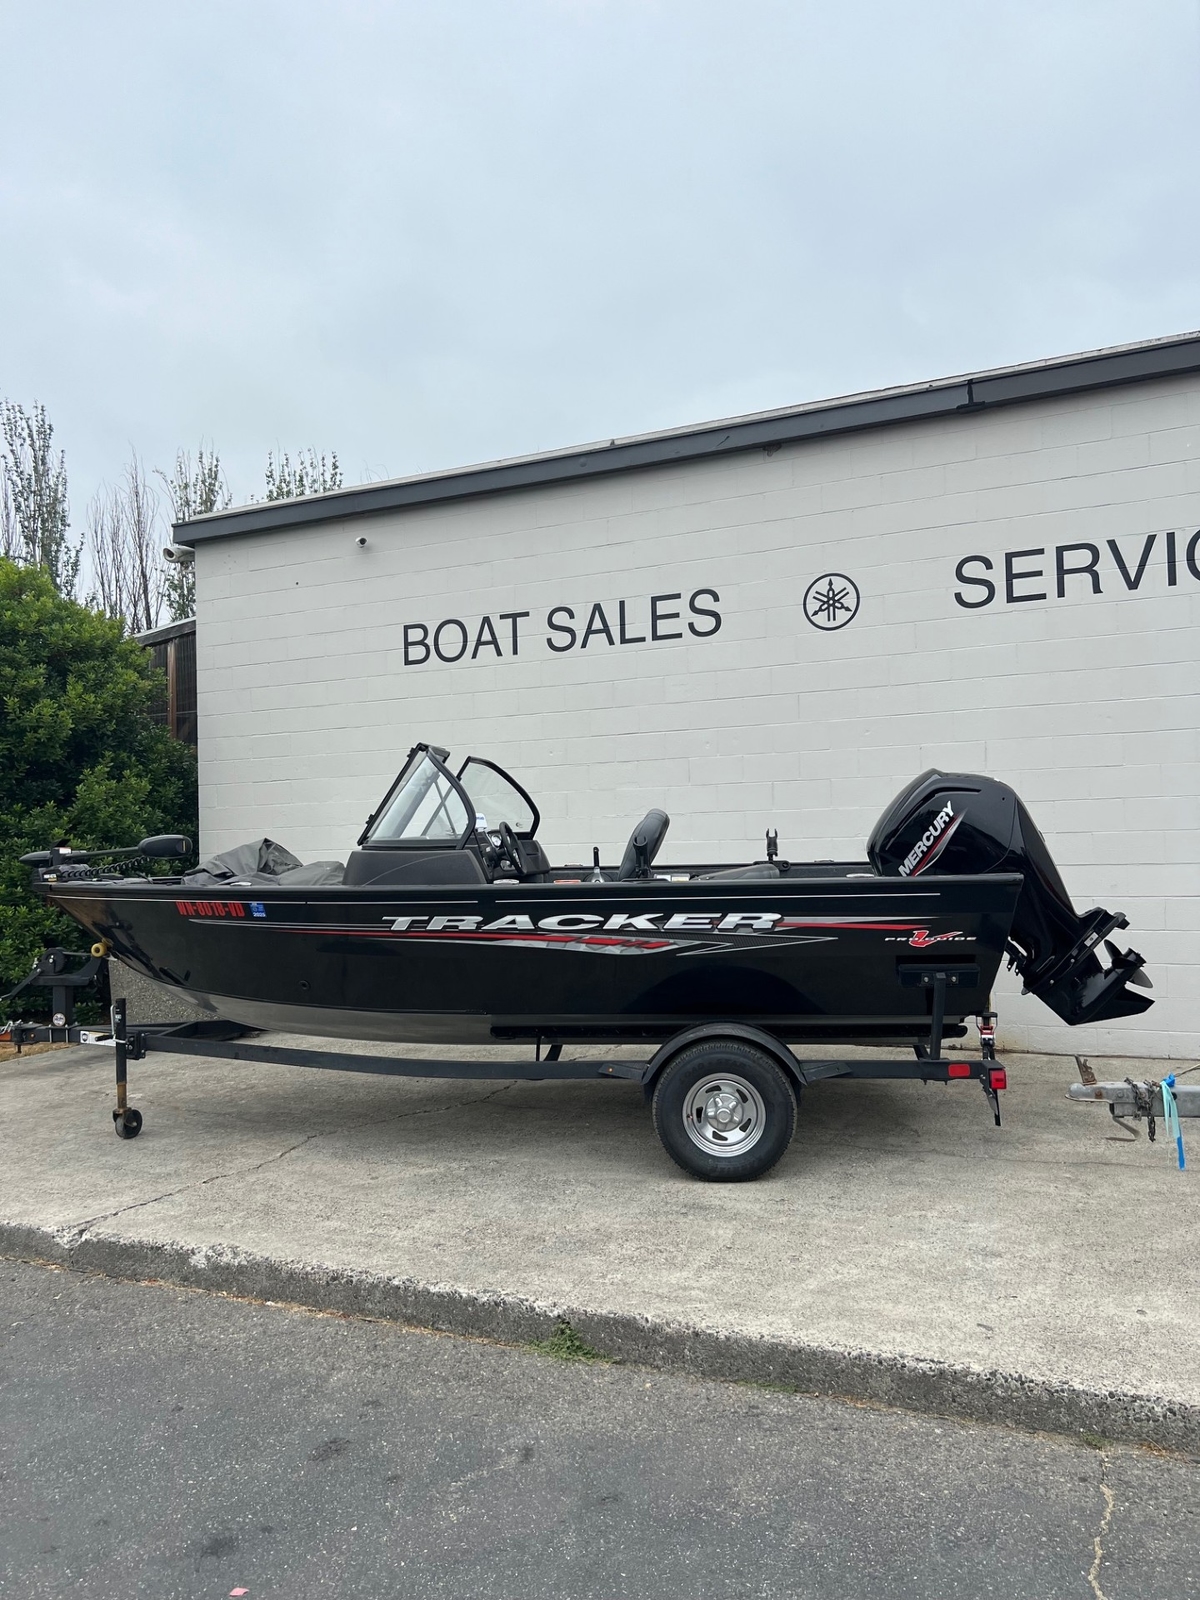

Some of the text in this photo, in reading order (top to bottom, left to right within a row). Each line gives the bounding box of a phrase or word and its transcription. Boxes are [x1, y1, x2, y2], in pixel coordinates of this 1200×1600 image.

[403, 611, 530, 666] BOAT
[546, 588, 722, 652] SALES
[898, 801, 955, 877] MERCURY
[382, 913, 783, 932] TRACKER
